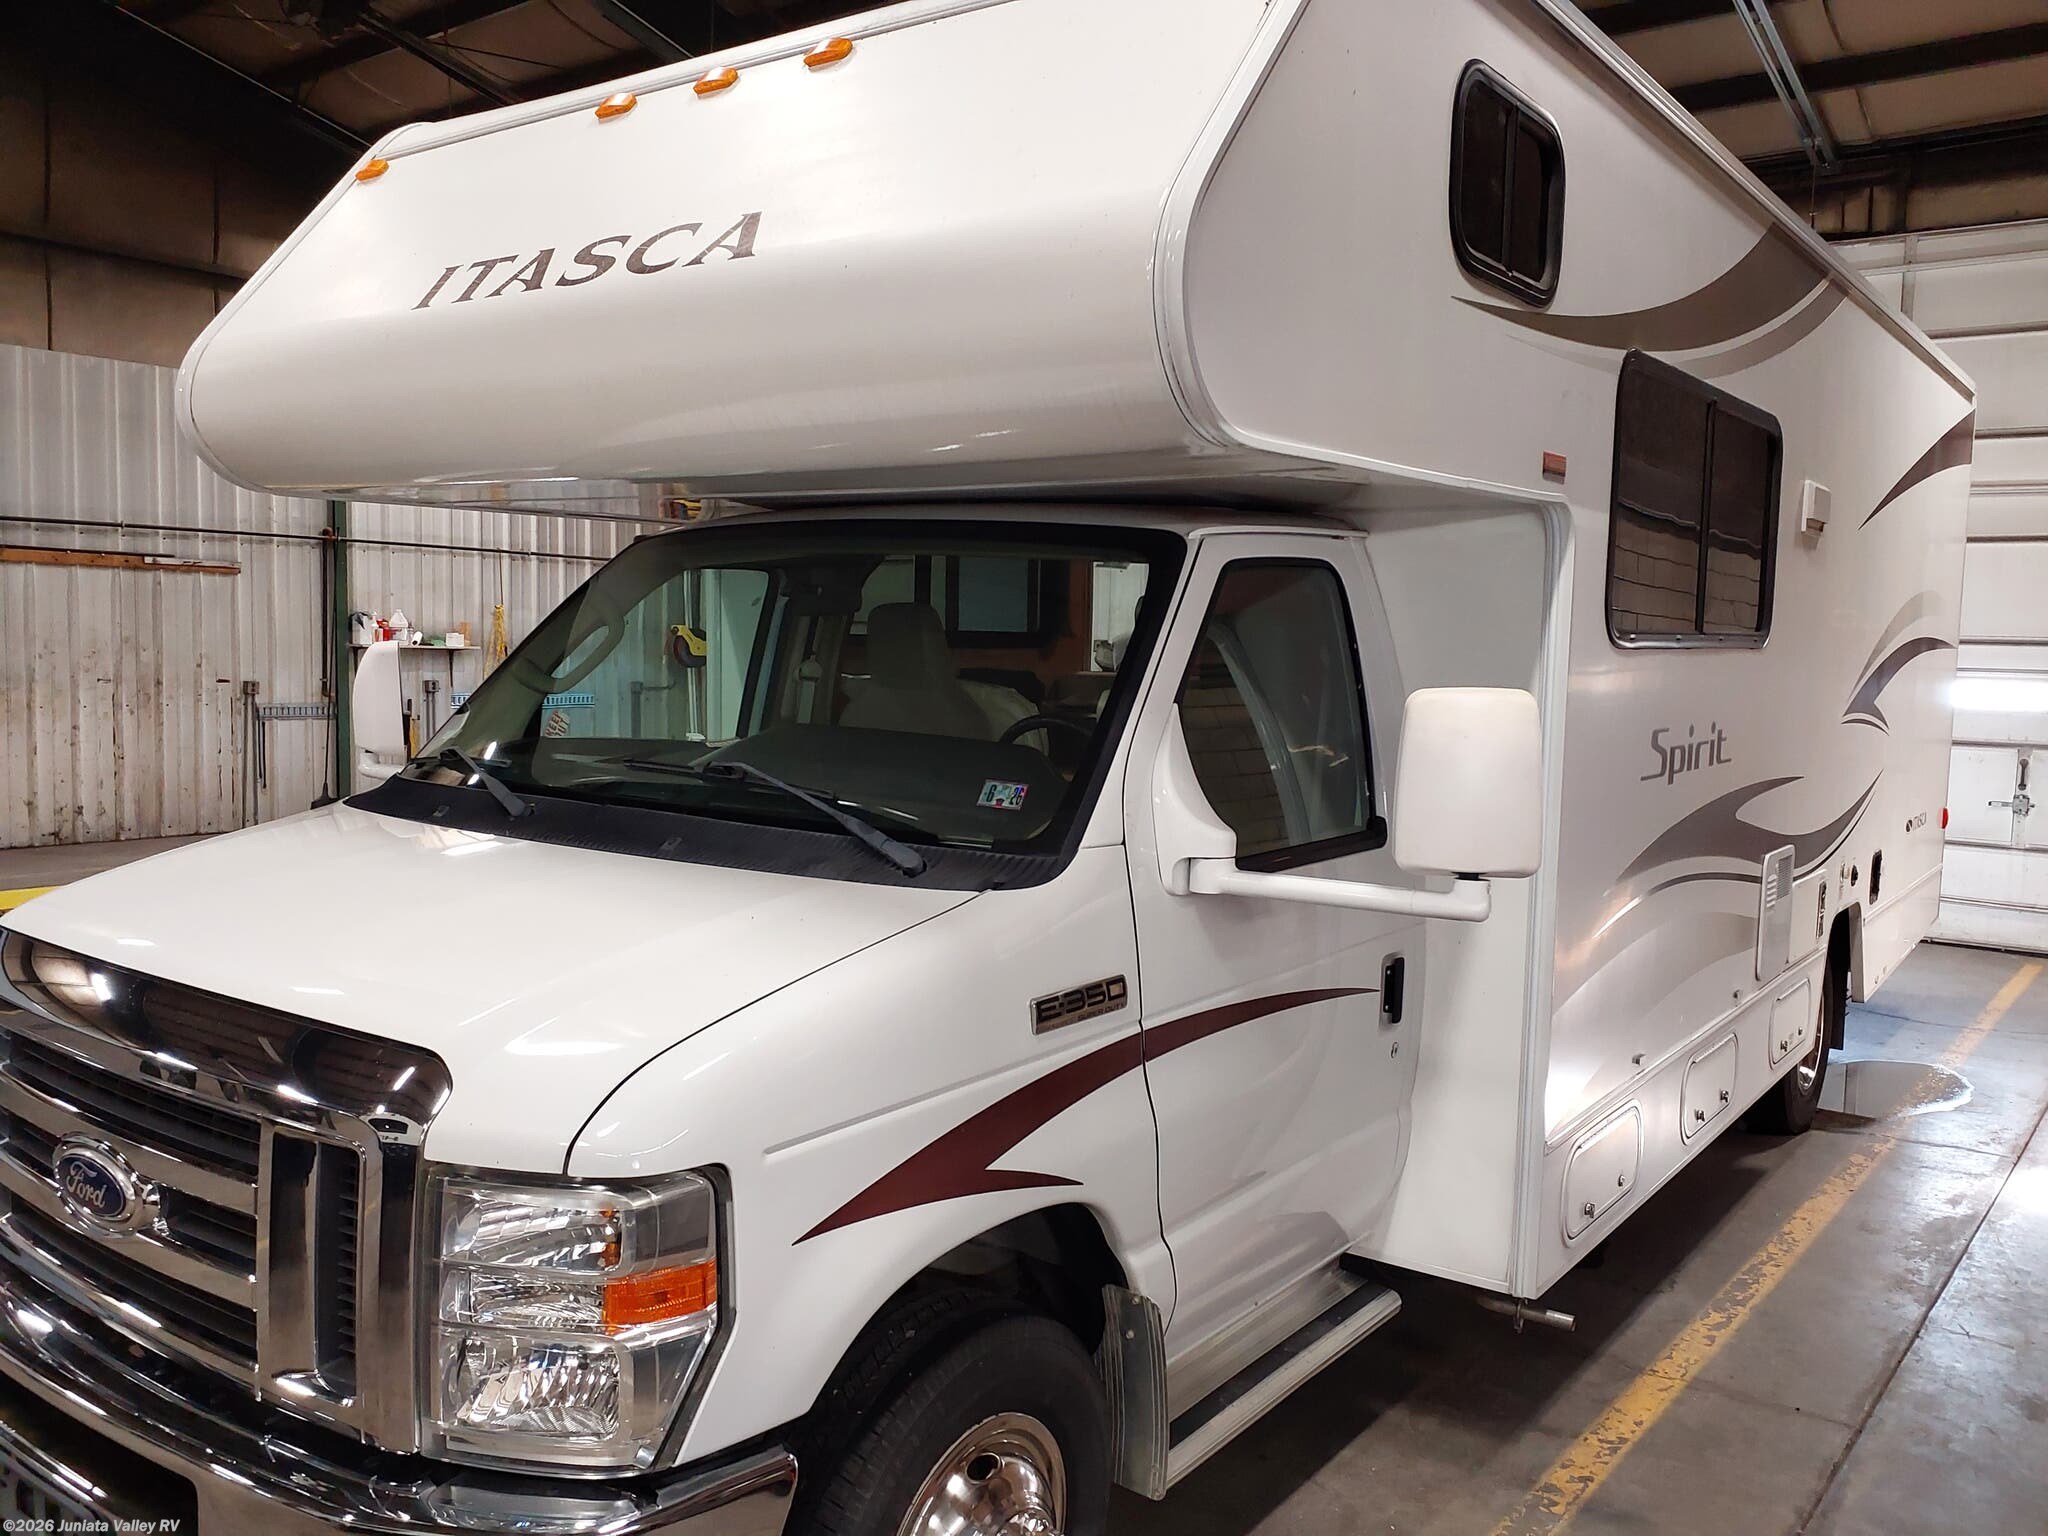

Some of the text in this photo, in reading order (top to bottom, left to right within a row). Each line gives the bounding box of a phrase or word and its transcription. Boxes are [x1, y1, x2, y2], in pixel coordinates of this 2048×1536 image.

[411, 211, 763, 311] ITASCA
[1640, 721, 1732, 785] Spirit
[986, 784, 1025, 806] 6 26
[66, 1160, 108, 1209] Ford
